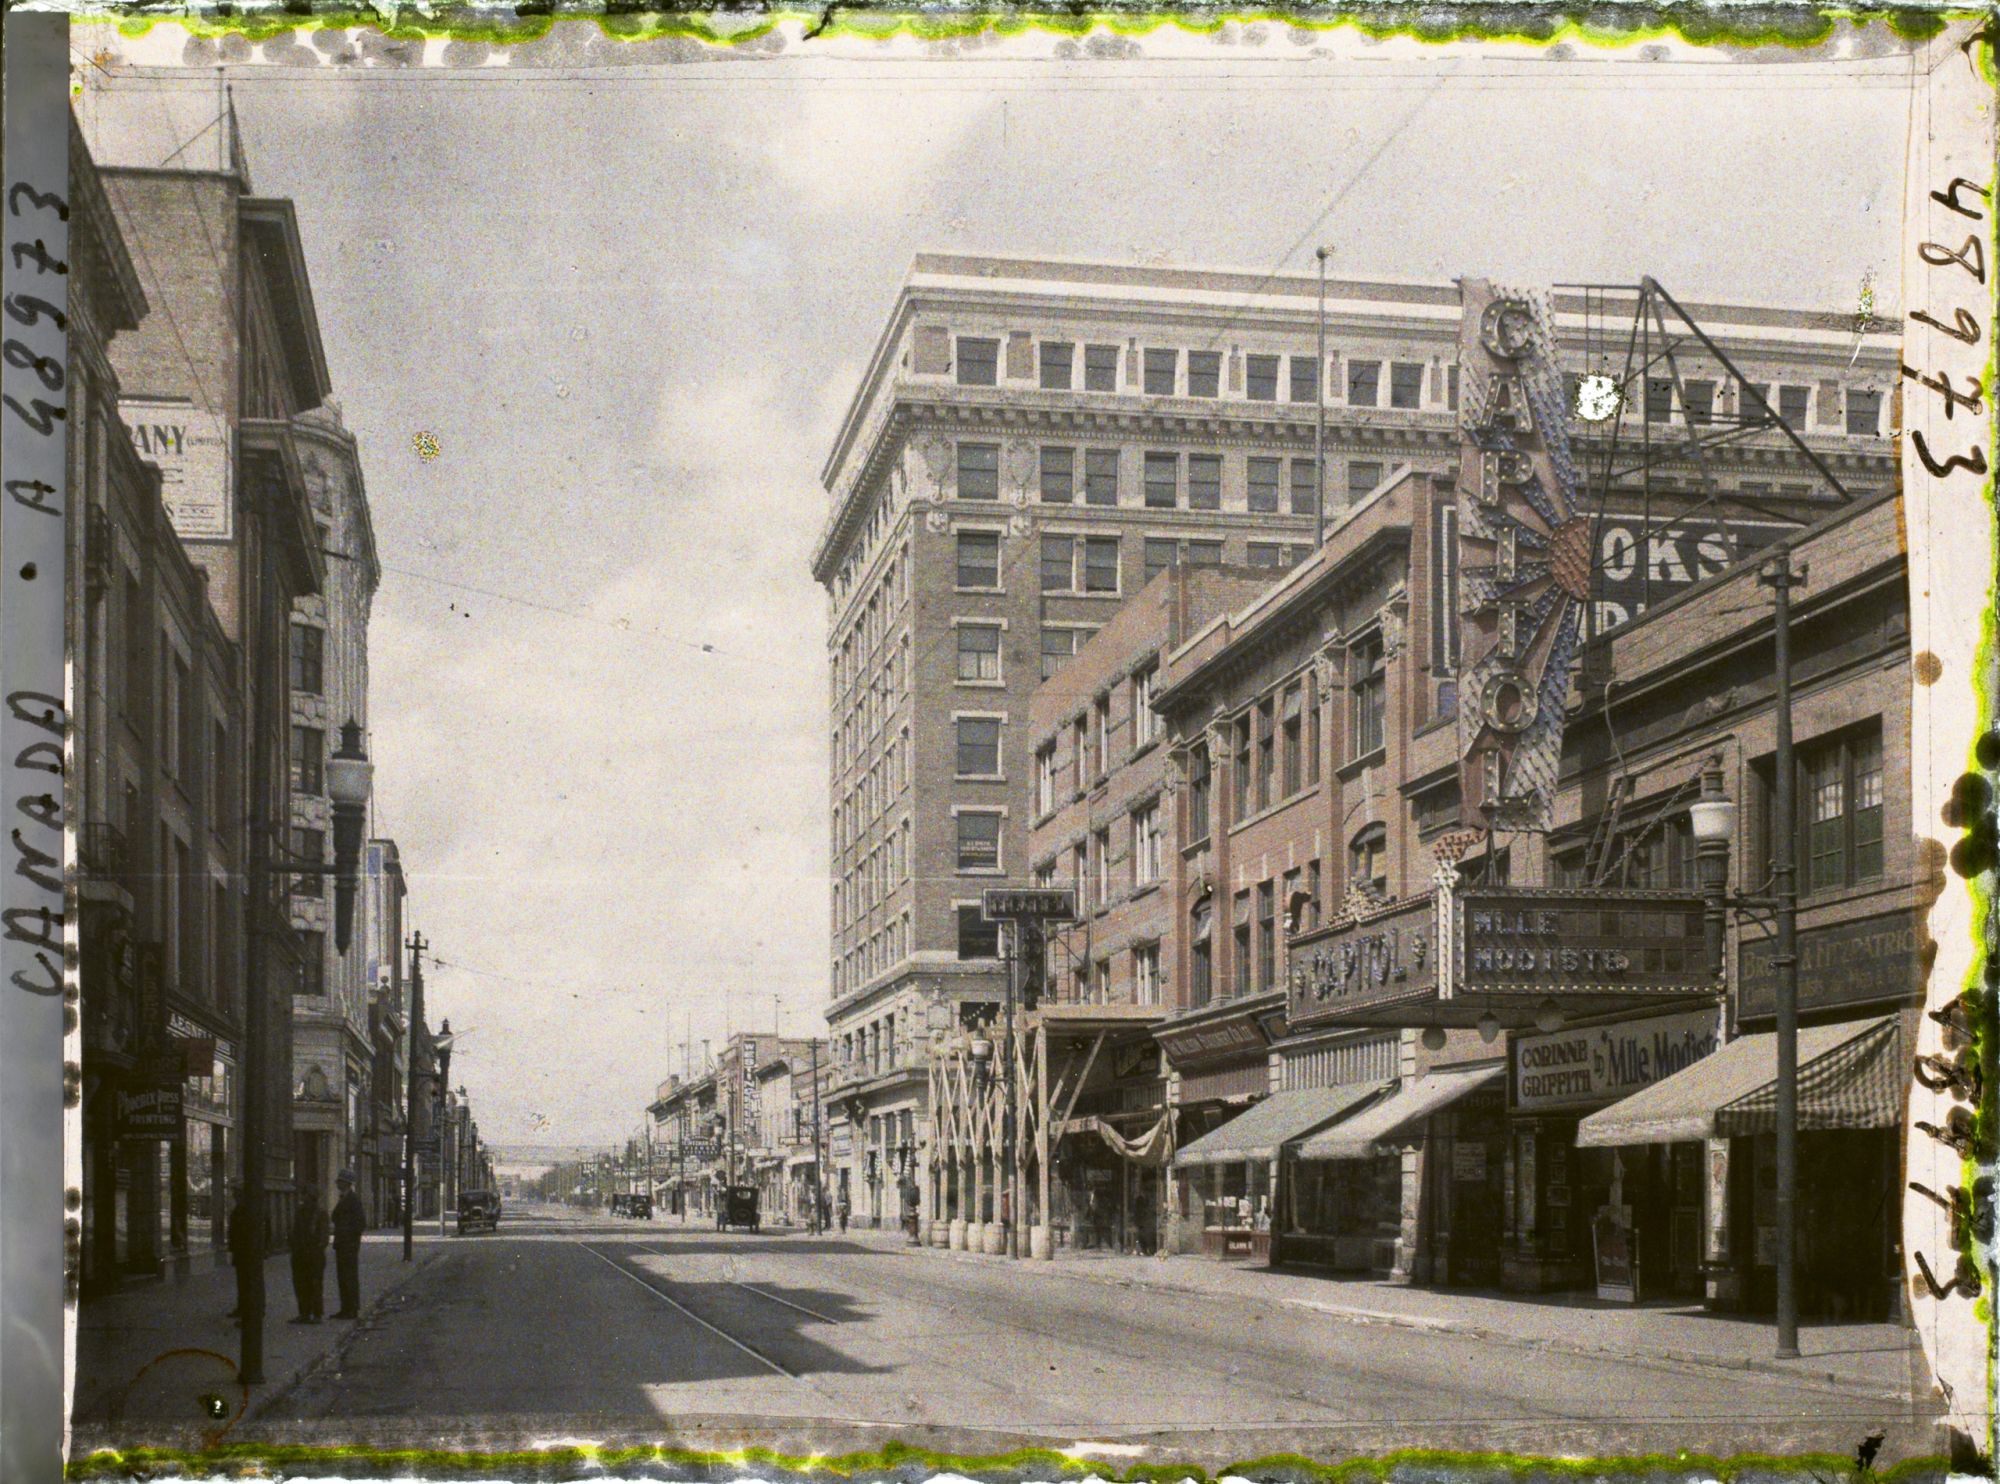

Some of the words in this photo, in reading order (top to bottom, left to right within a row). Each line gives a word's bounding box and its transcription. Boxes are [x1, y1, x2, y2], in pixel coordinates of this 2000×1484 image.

[1902, 178, 1990, 480] 48973
[133, 423, 187, 456] ANY
[5, 480, 62, 517] A
[1475, 298, 1541, 809] CAPITOL
[3, 690, 65, 996] CANADA
[1473, 911, 1559, 937] MLLE
[1312, 928, 1406, 1000] CAPITOL
[1473, 946, 1618, 974] MODISTE
[1522, 1039, 1588, 1069] CORINNE
[1522, 1069, 1593, 1097] GRIFFITH
[128, 1115, 178, 1127] PRINTING
